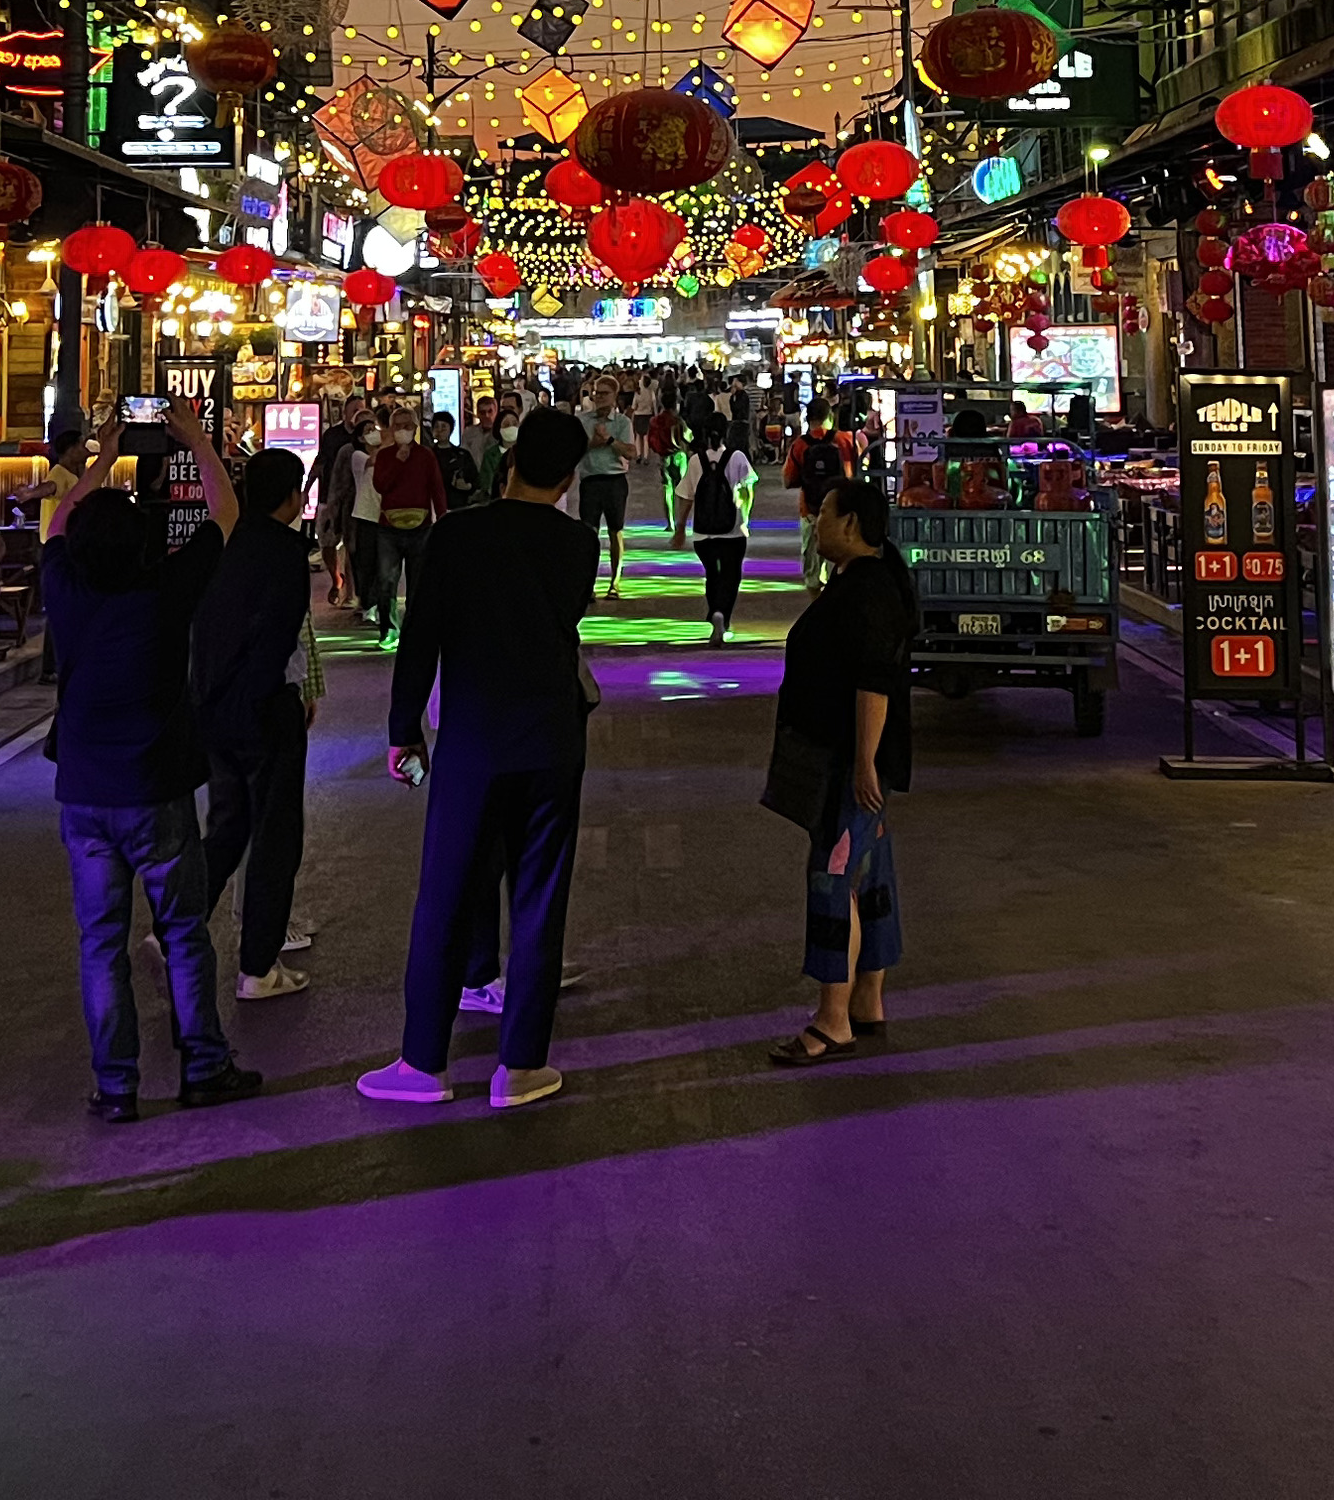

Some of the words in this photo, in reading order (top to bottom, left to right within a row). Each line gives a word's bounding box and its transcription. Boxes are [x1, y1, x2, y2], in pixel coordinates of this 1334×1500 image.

[167, 369, 216, 399] BUY
[204, 399, 215, 419] 2
[1197, 398, 1262, 422] TEMPLE
[1192, 443, 1227, 452] SUNDAY
[1232, 443, 1243, 452] TO
[1247, 443, 1280, 452] FRIDAY
[170, 465, 200, 481] BEE
[173, 486, 203, 499] $1.00
[1020, 549, 1045, 564] 68
[1198, 555, 1231, 578] 1+1
[1246, 558, 1284, 576] $0.75
[1196, 616, 1288, 630] COCKTAIL
[1219, 640, 1265, 672] 1+1
